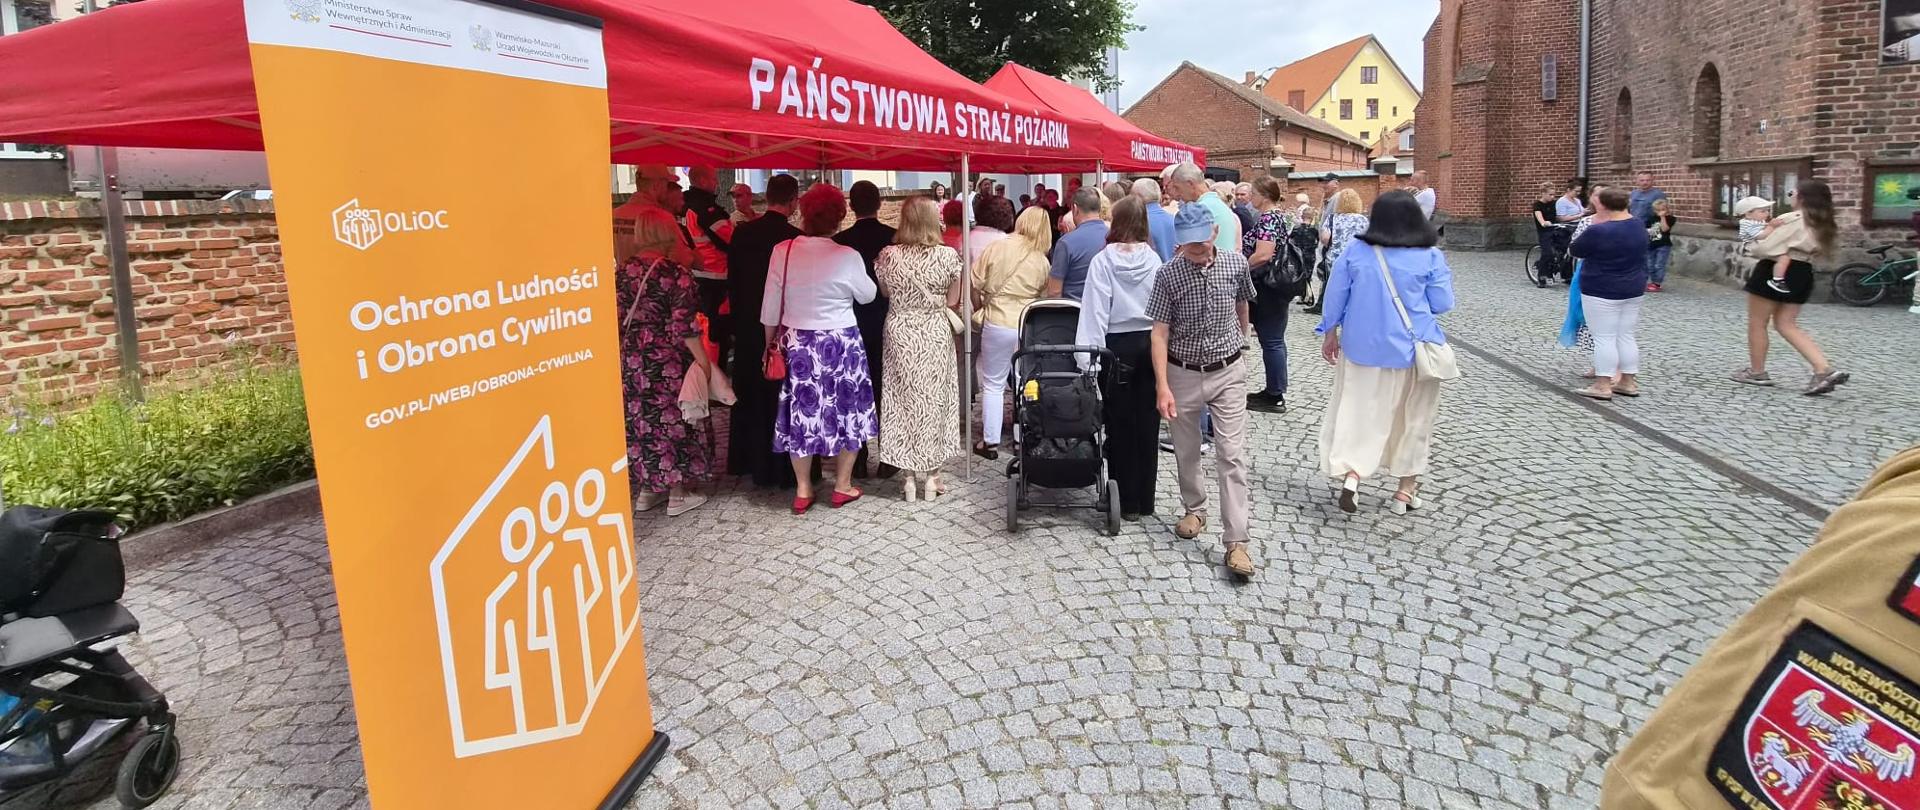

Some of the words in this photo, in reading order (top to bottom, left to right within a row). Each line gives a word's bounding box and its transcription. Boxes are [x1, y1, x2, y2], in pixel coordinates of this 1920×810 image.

[325, 8, 395, 29] Wewnętrznych
[399, 22, 452, 40] Administracji
[386, 8, 413, 22] Spraw
[496, 41, 516, 53] Urząd
[561, 53, 590, 65] Olsztynie
[748, 57, 949, 136] PAŃSTWOWA
[955, 101, 1011, 144] STRAŻ
[1014, 109, 1070, 150] POŻARNA
[384, 209, 449, 232] OLiOC
[350, 289, 490, 331] Ochrona
[497, 266, 599, 305] Ludności
[356, 350, 368, 380] i
[377, 328, 496, 374] Obrona
[501, 307, 592, 345] Cywilna
[365, 348, 594, 429] GOV.PL/WEB/OBRONA-CYWILNA
